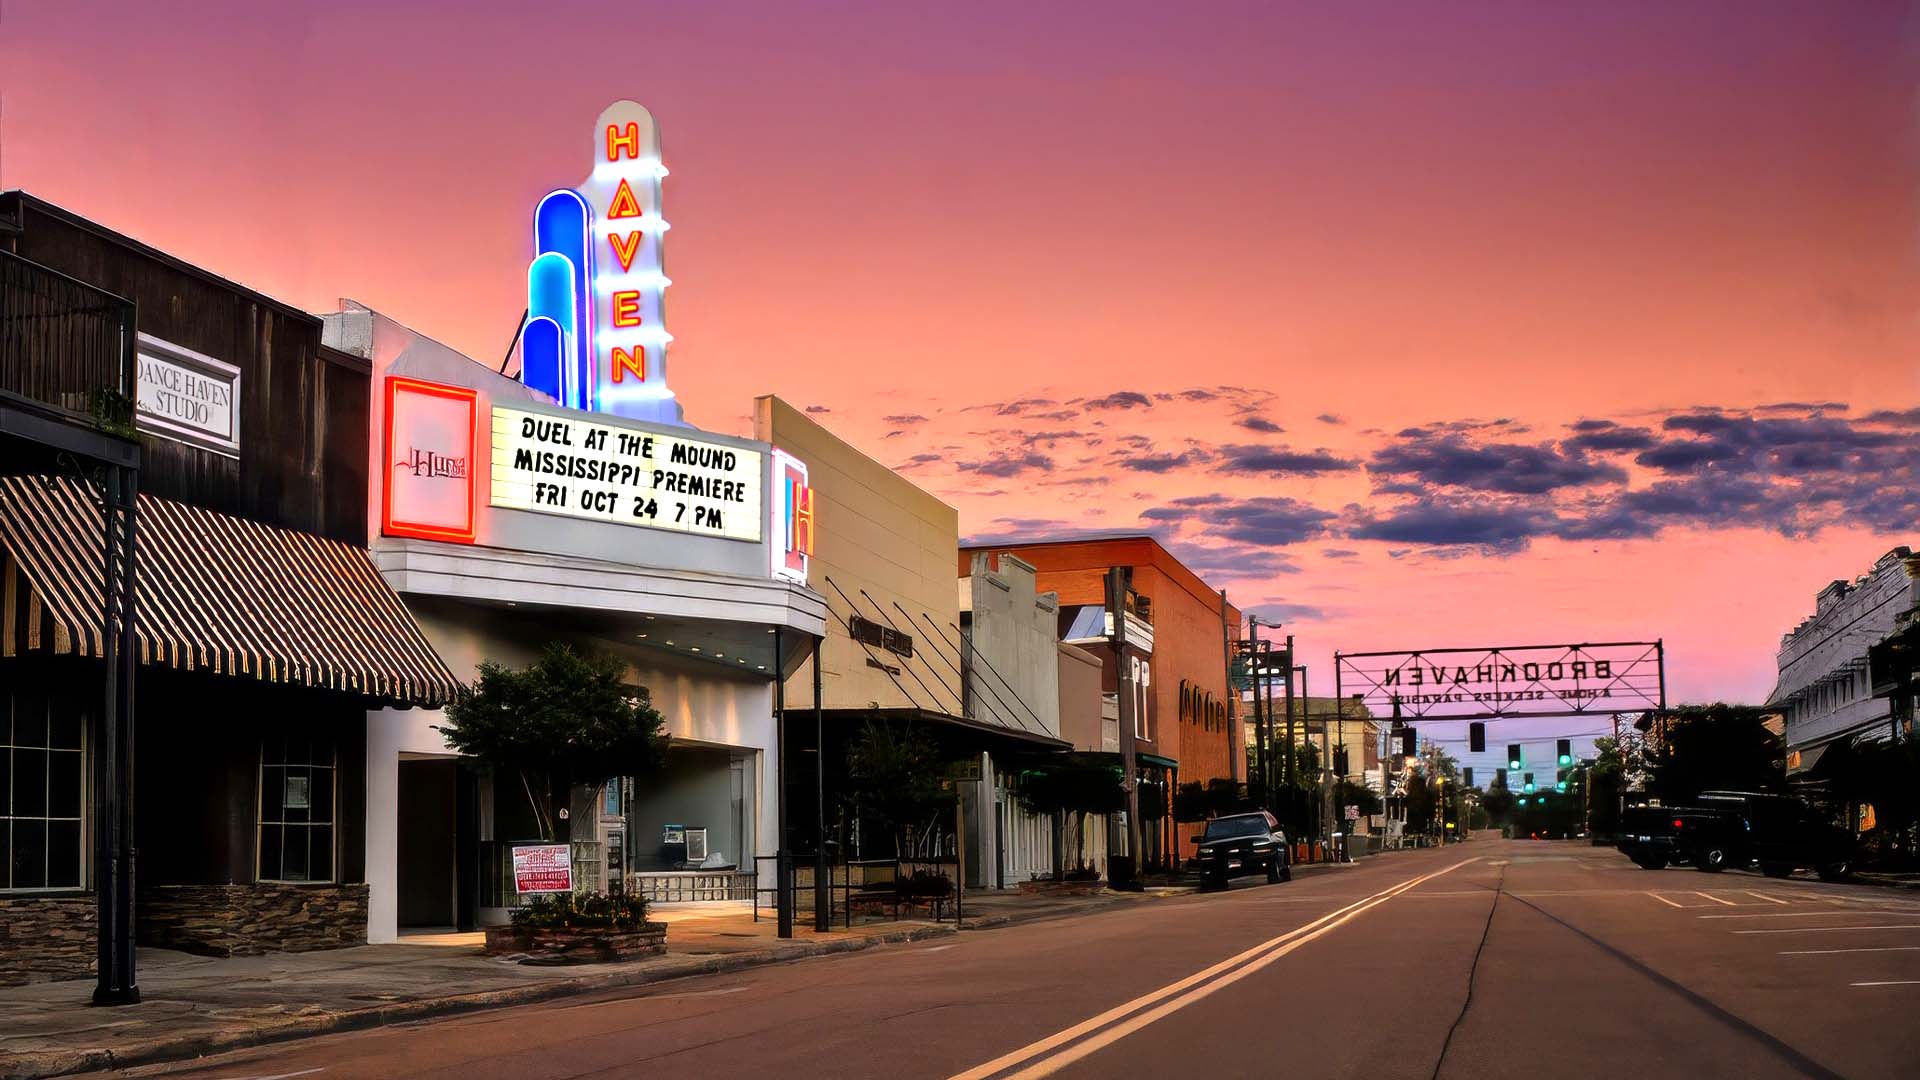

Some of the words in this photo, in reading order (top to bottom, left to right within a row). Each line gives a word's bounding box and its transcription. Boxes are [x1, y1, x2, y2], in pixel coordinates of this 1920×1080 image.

[606, 122, 643, 384] HAVEN
[156, 389, 208, 424] STUDIO
[185, 374, 229, 407] HAVEN
[521, 417, 572, 446] DUEL
[584, 428, 608, 451] AT
[618, 433, 654, 459] THE
[670, 442, 736, 472] MOUND
[514, 448, 640, 486] MISSISSIPPI
[652, 469, 746, 502] PREMIERE
[535, 482, 567, 507] FRI
[580, 489, 618, 514] OCT
[632, 496, 658, 519] 24
[674, 502, 686, 523] 7
[694, 505, 723, 529] PM
